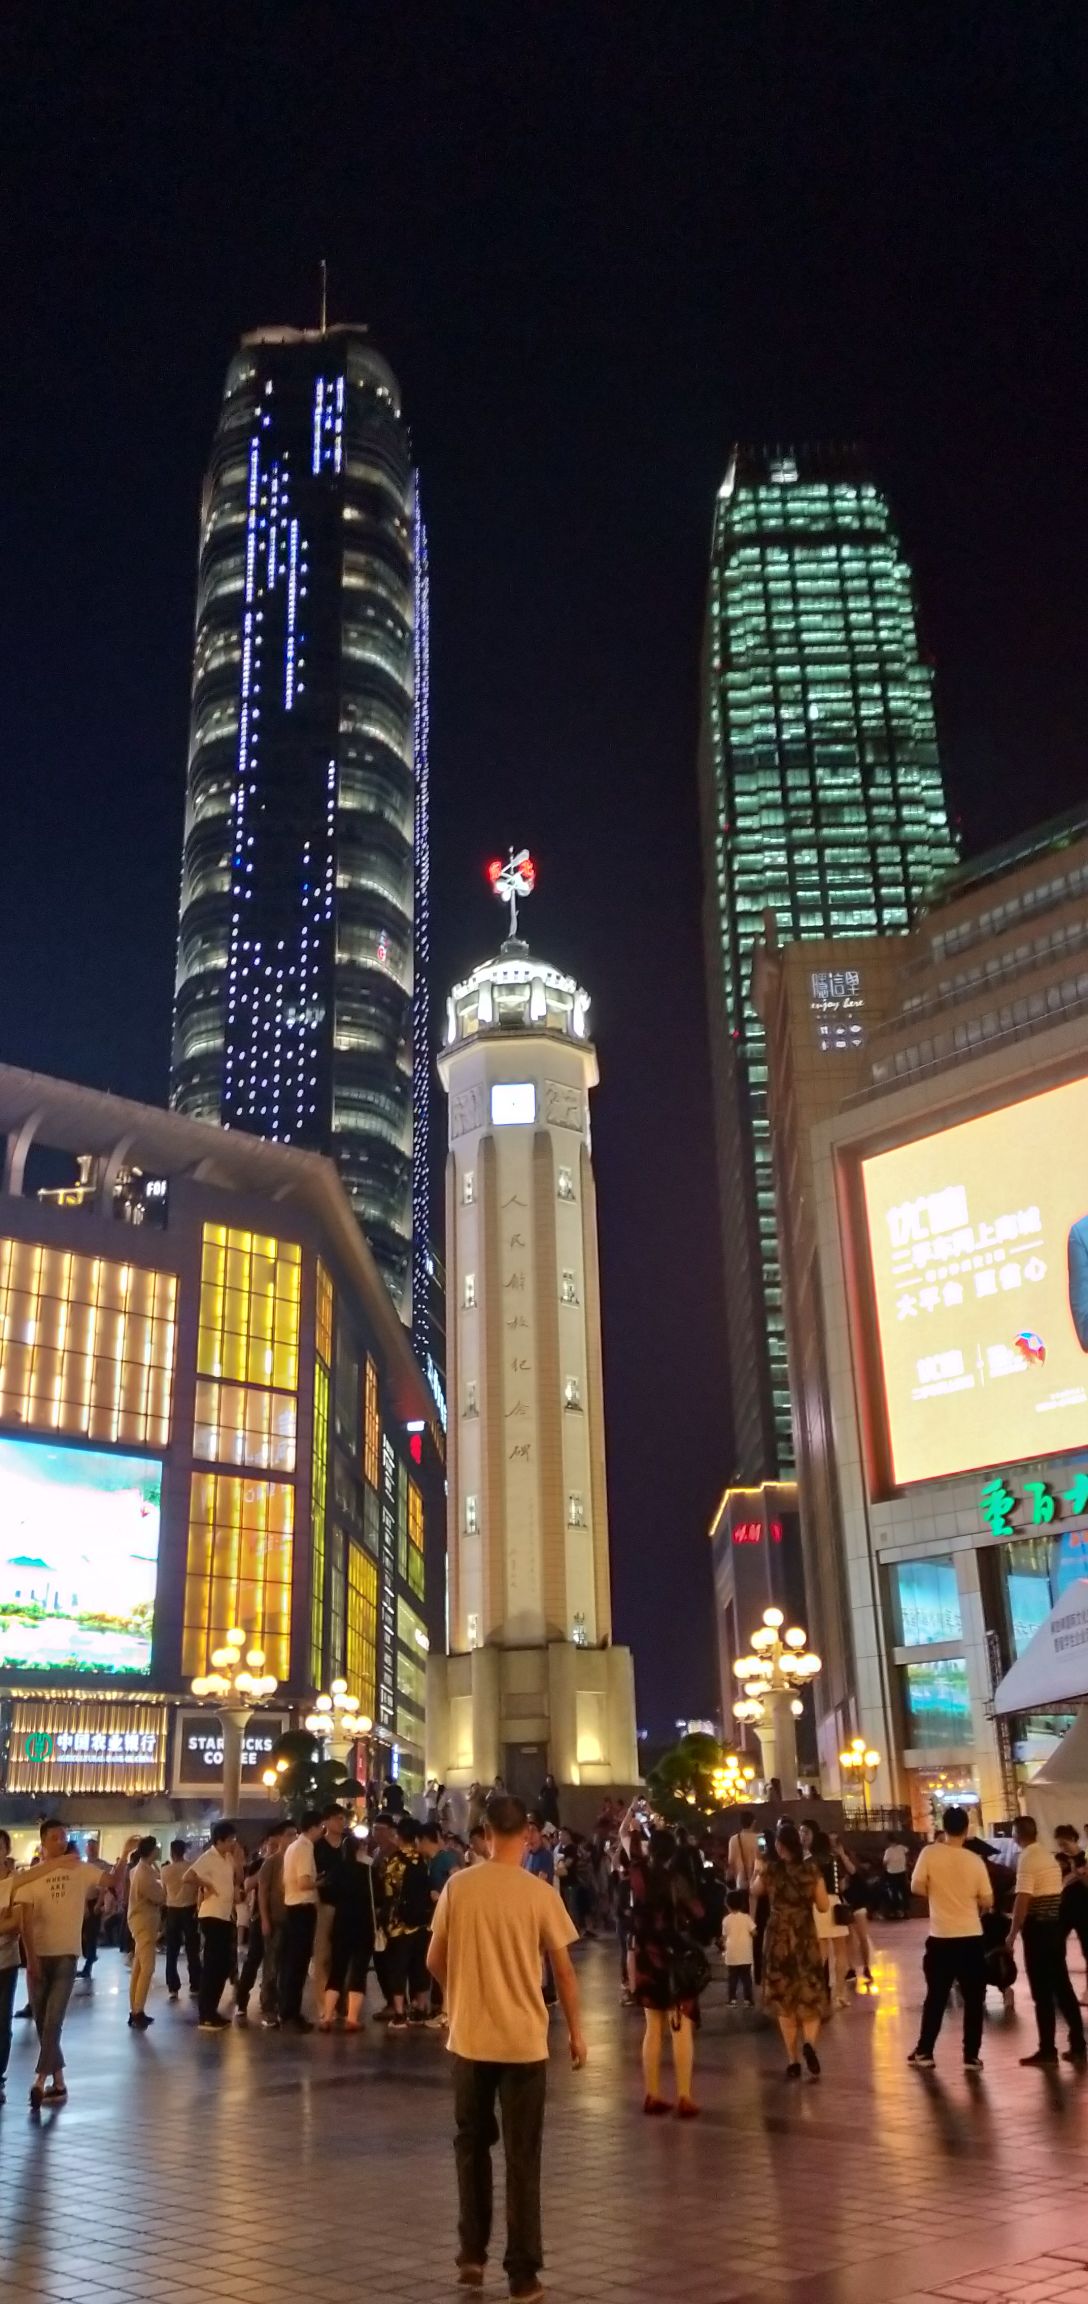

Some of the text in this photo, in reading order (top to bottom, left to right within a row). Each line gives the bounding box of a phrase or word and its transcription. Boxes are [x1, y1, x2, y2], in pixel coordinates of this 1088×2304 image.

[810, 999, 840, 1012] enjoy
[57, 1732, 156, 1752] 中国农业银行
[188, 1737, 273, 1751] STARCKS
[203, 1752, 257, 1765] COEE
